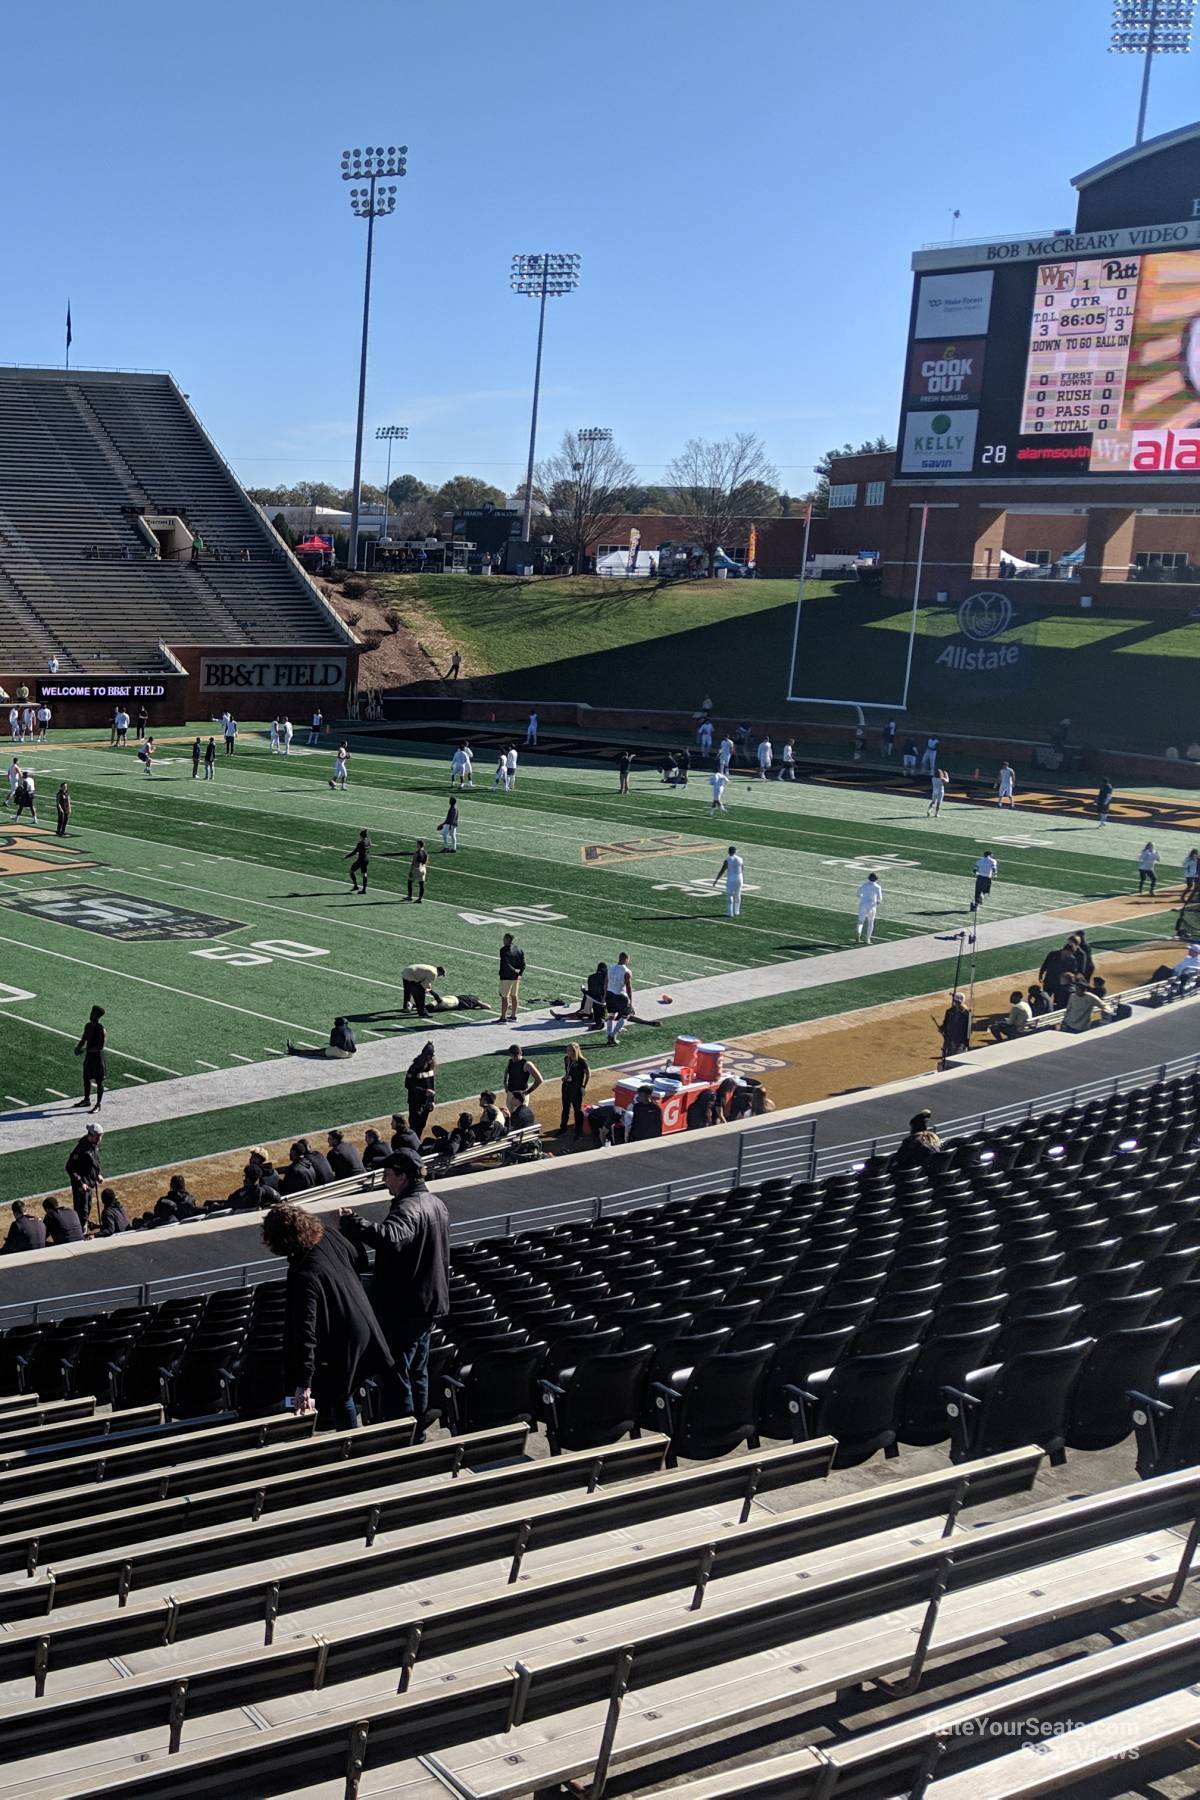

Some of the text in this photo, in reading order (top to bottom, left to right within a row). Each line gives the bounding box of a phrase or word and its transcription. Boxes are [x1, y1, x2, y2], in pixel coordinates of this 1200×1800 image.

[986, 244, 1020, 261] BOB
[1026, 233, 1120, 256] McCREARY
[1129, 225, 1189, 245] VIDEO
[1040, 265, 1074, 291] WF
[1102, 260, 1138, 281] Pitt
[1082, 279, 1090, 291] 1
[1045, 295, 1054, 307] 0
[1117, 287, 1127, 300] 0
[1071, 296, 1100, 308] QTR
[1060, 313, 1105, 327] 86:05
[1115, 319, 1125, 331] 3
[1040, 324, 1049, 336] 3
[1032, 335, 1129, 352] DOWN TO GO BALL ON
[921, 358, 974, 377] COOK
[1061, 371, 1093, 380] FIRST
[928, 375, 965, 393] OUT
[1040, 375, 1048, 386] 0
[1106, 371, 1114, 383] 0
[1037, 388, 1112, 402] 0 RUSH 0
[1036, 404, 1110, 417] 0 PASS 0
[1034, 419, 1107, 432] 0 TOTAL 0
[914, 435, 964, 451] KELLY
[982, 445, 1006, 463] 28
[921, 459, 952, 469] savin
[936, 645, 1019, 670] Allstate
[205, 664, 342, 687] BB&T FIELD
[41, 686, 165, 696] WELCOME TO BB&T FIELD
[582, 834, 726, 863] ACC
[822, 853, 921, 872] 20
[457, 904, 568, 926] 40
[191, 939, 331, 966] 50
[663, 1099, 681, 1127] G
